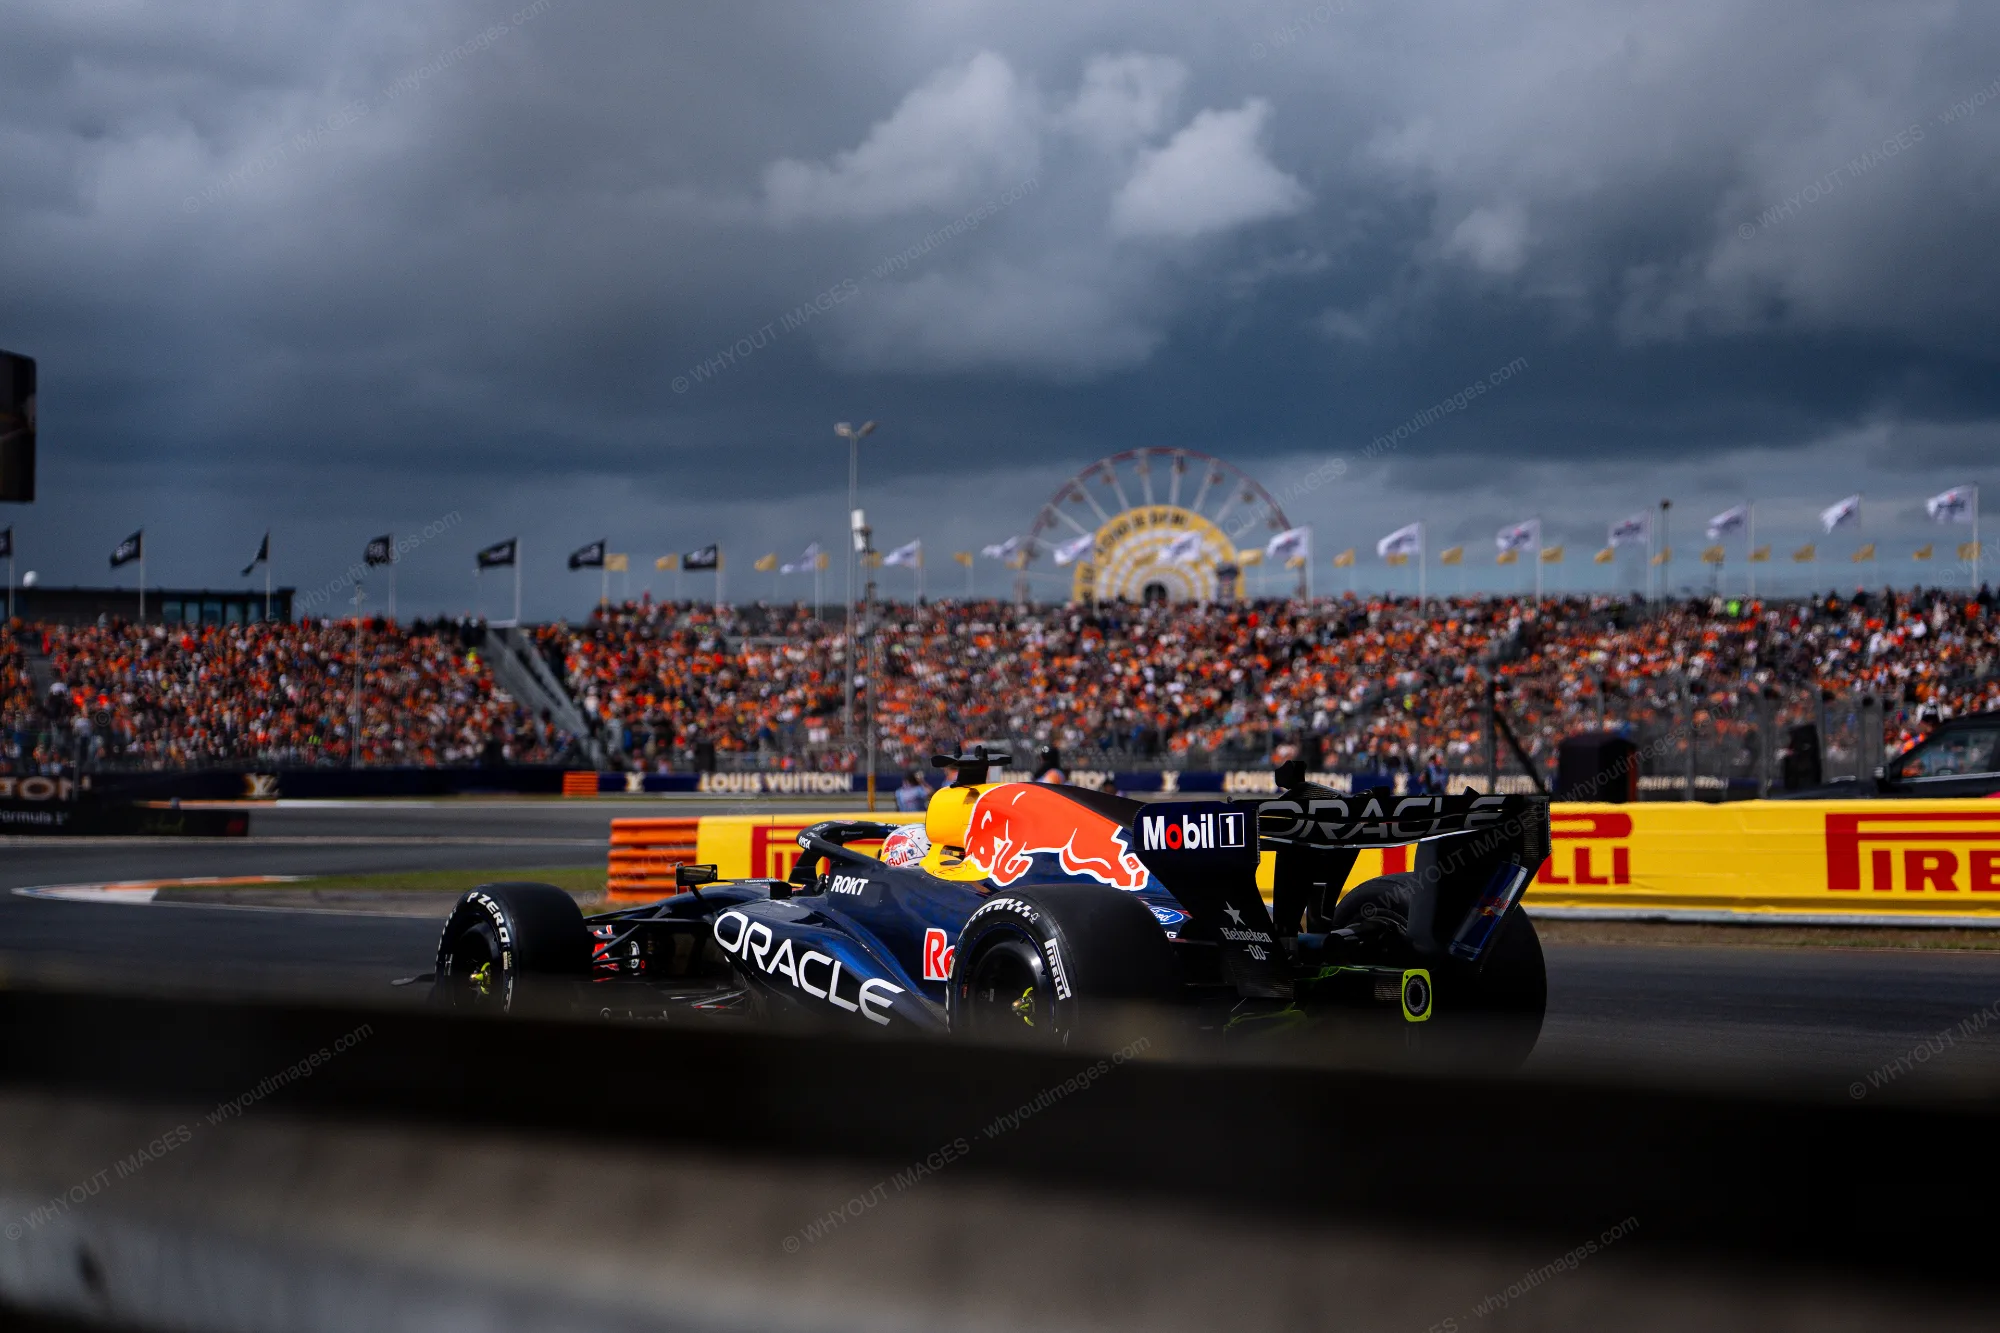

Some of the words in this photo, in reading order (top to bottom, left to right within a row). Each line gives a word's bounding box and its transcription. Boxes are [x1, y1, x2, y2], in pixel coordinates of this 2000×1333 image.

[700, 772, 763, 794] LOUIS
[764, 772, 853, 792] VUITTON
[0, 811, 53, 823] ormula
[1142, 812, 1215, 851] Mobil
[1259, 797, 1506, 840] ORACLE
[477, 893, 511, 943] ZERO
[1220, 927, 1273, 944] Heineken
[713, 911, 906, 1026] ORACLE
[1043, 938, 1072, 1000] PIRELLI
